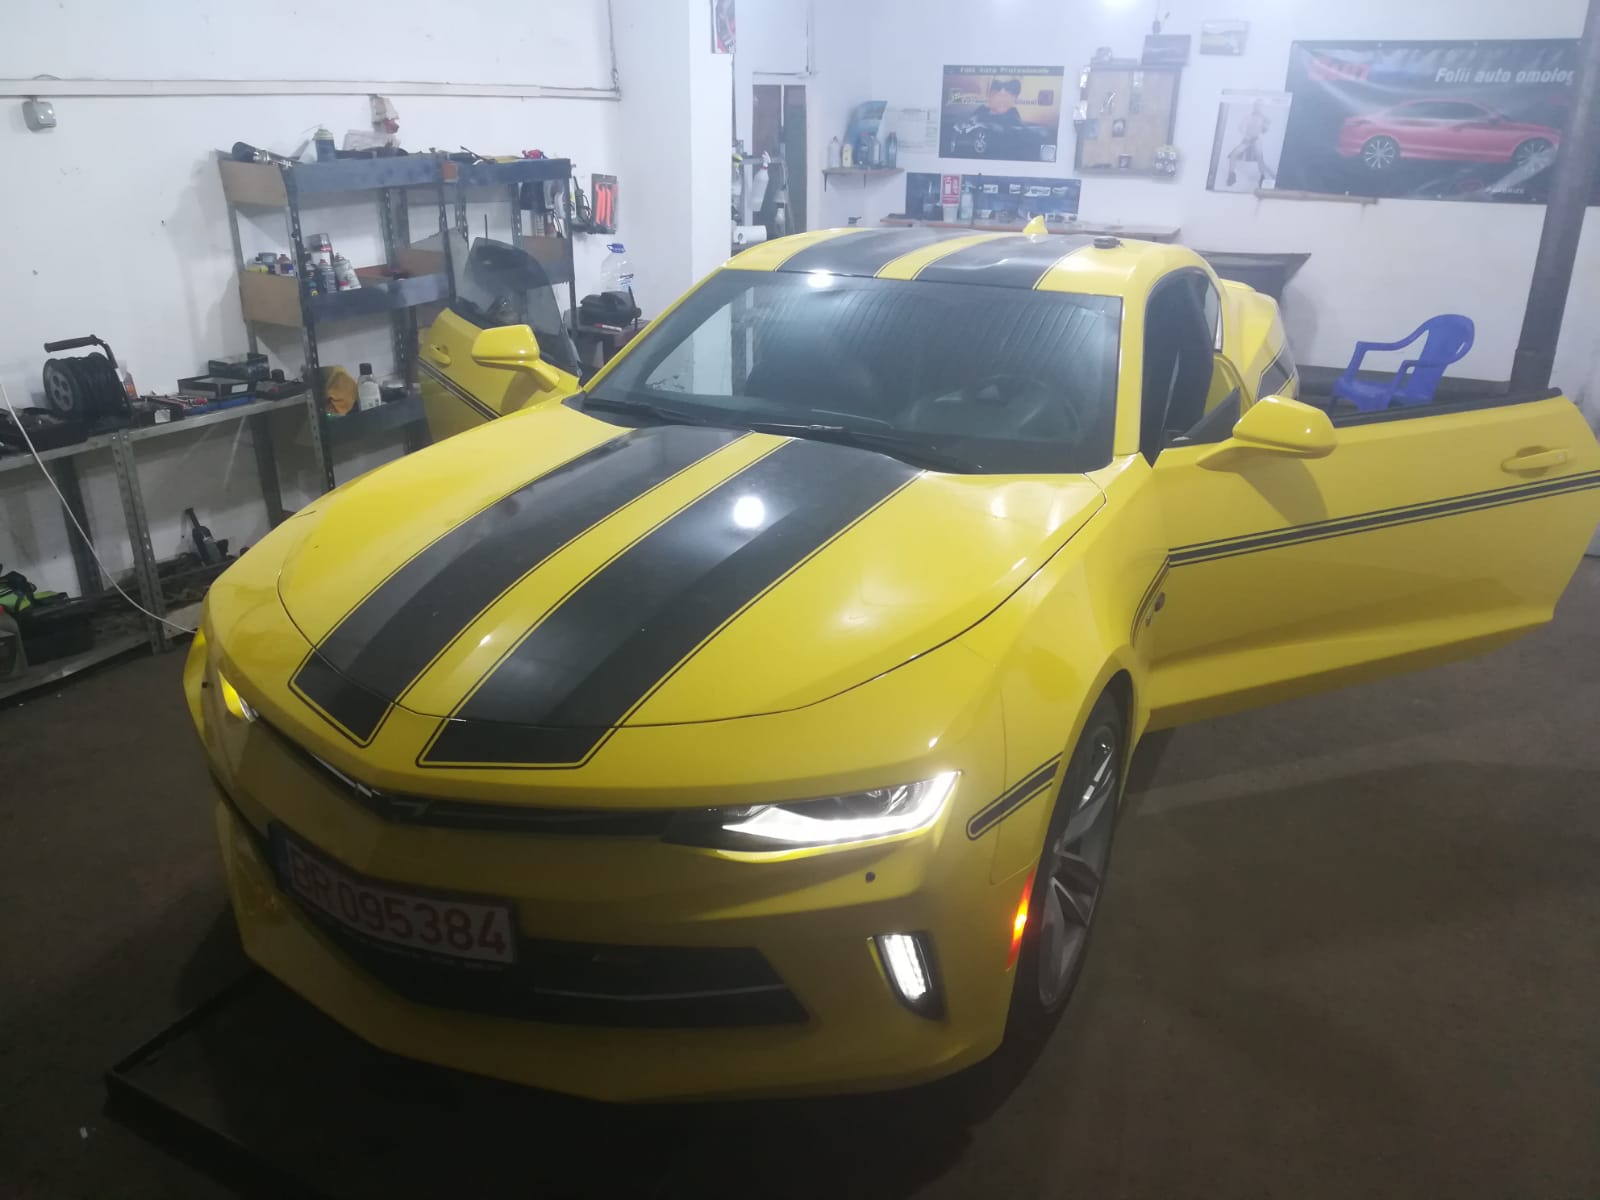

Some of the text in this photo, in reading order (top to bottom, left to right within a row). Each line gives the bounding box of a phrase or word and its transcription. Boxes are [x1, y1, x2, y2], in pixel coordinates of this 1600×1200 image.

[1435, 67, 1471, 83] Folii
[1474, 68, 1512, 83] auto
[338, 881, 507, 955] 095384
